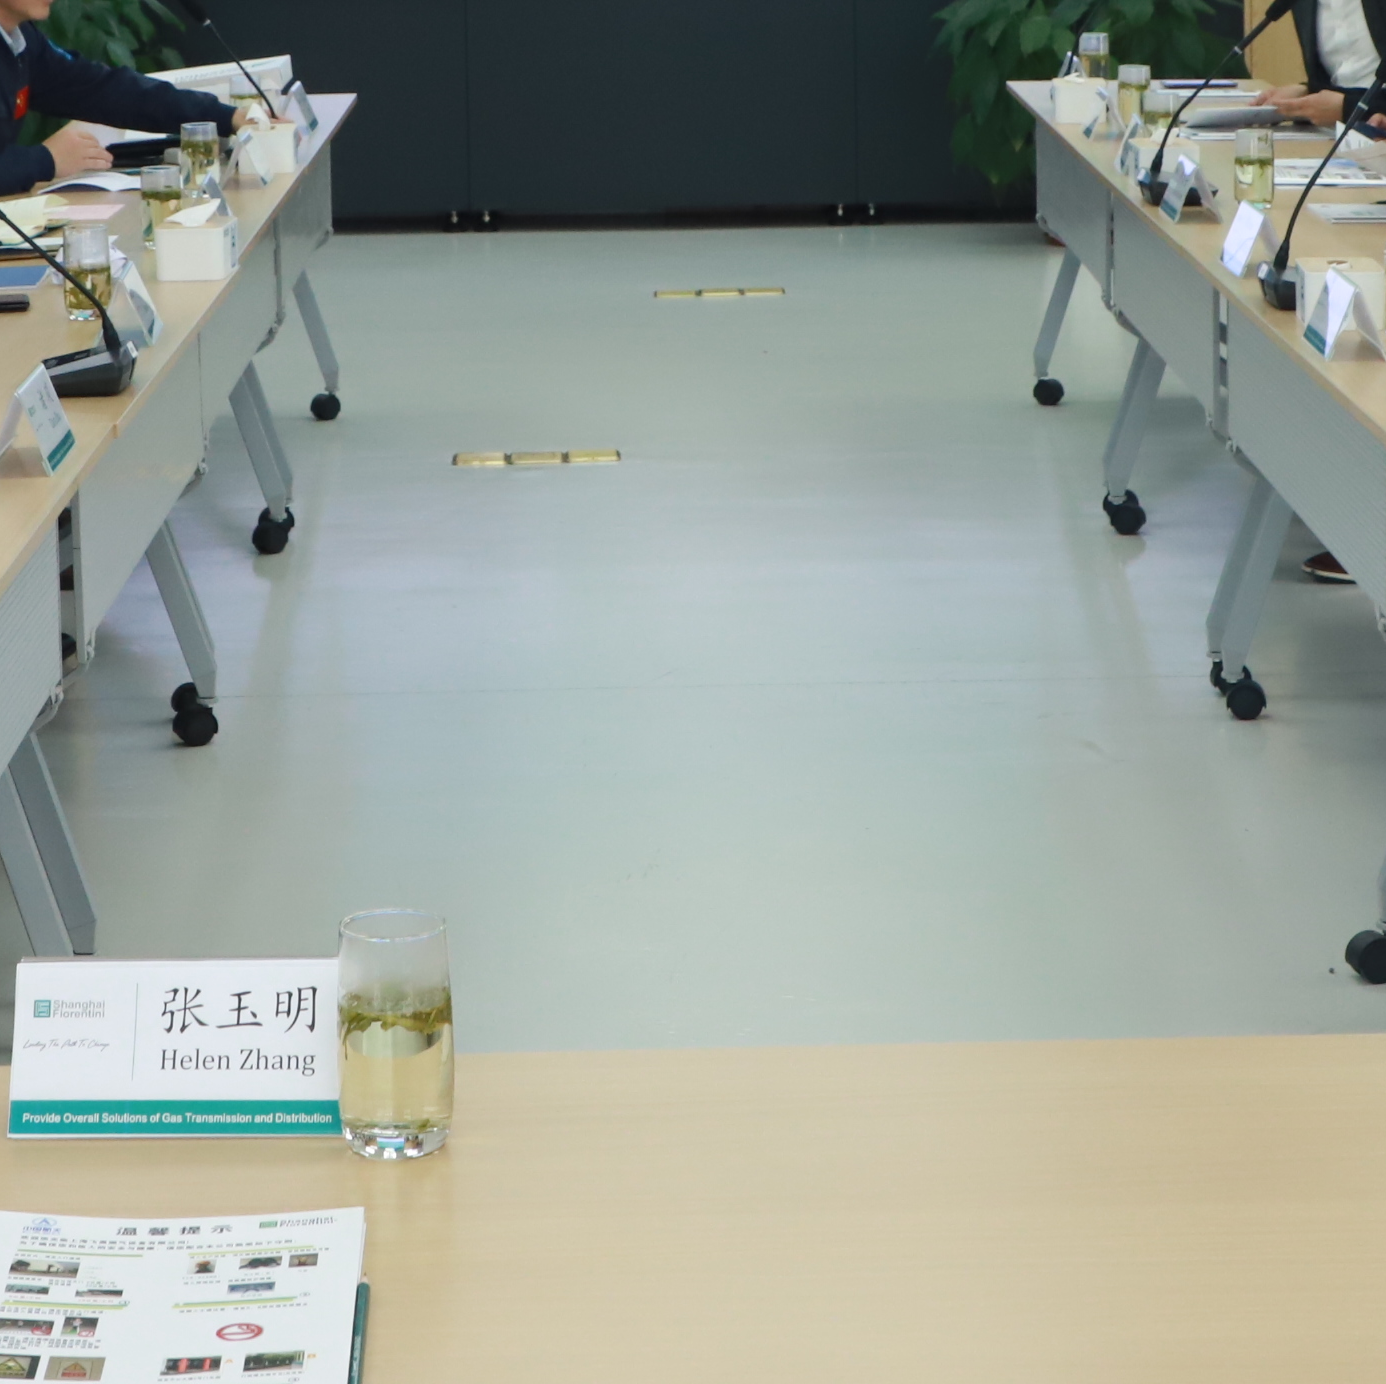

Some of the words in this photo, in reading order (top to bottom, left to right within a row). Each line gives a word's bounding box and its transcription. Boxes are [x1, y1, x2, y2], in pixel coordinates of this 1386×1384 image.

[53, 1000, 105, 1012] Shanghai
[160, 986, 318, 1034] 张玉明
[160, 1049, 231, 1071] Helen
[239, 1049, 316, 1077] Zhang
[22, 1112, 61, 1123] Provide
[63, 1112, 99, 1123] Overall
[101, 1112, 147, 1123] Solutions
[149, 1112, 161, 1123] of
[162, 1112, 182, 1123] Gas
[185, 1112, 252, 1123] Transmission
[254, 1112, 273, 1123] and
[275, 1112, 332, 1123] Distribution
